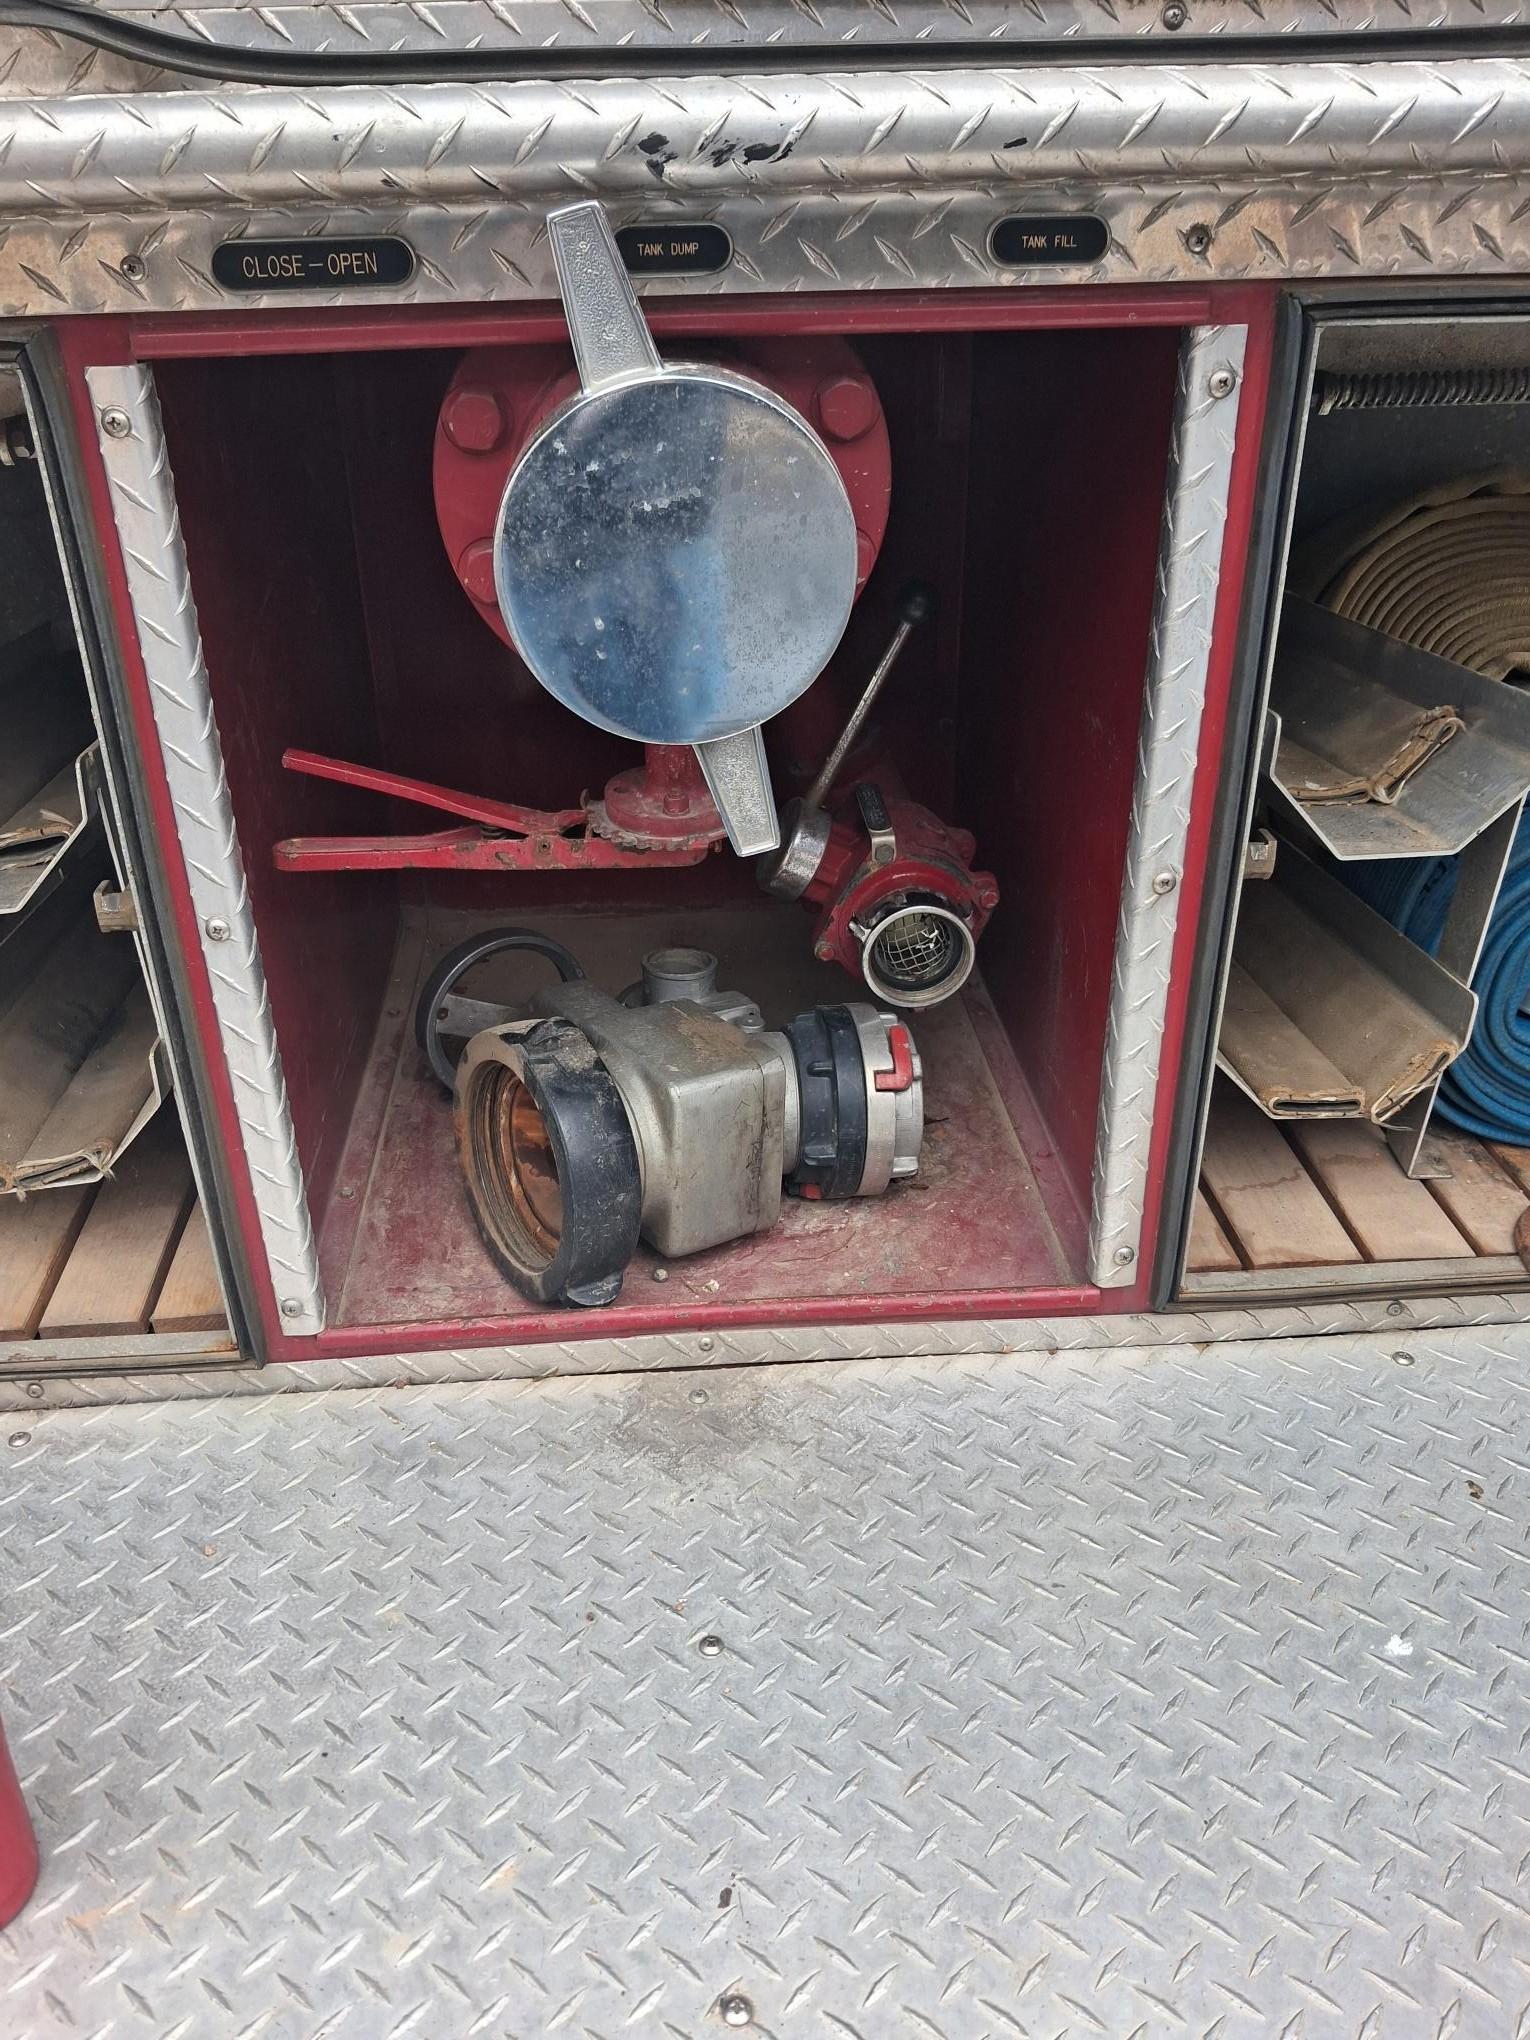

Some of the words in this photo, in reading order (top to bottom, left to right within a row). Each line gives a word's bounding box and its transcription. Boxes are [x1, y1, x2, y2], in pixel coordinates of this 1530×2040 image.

[1021, 235, 1047, 248] TANK
[1054, 234, 1078, 248] FILL
[637, 243, 663, 256] TANK
[671, 242, 699, 255] DUMP
